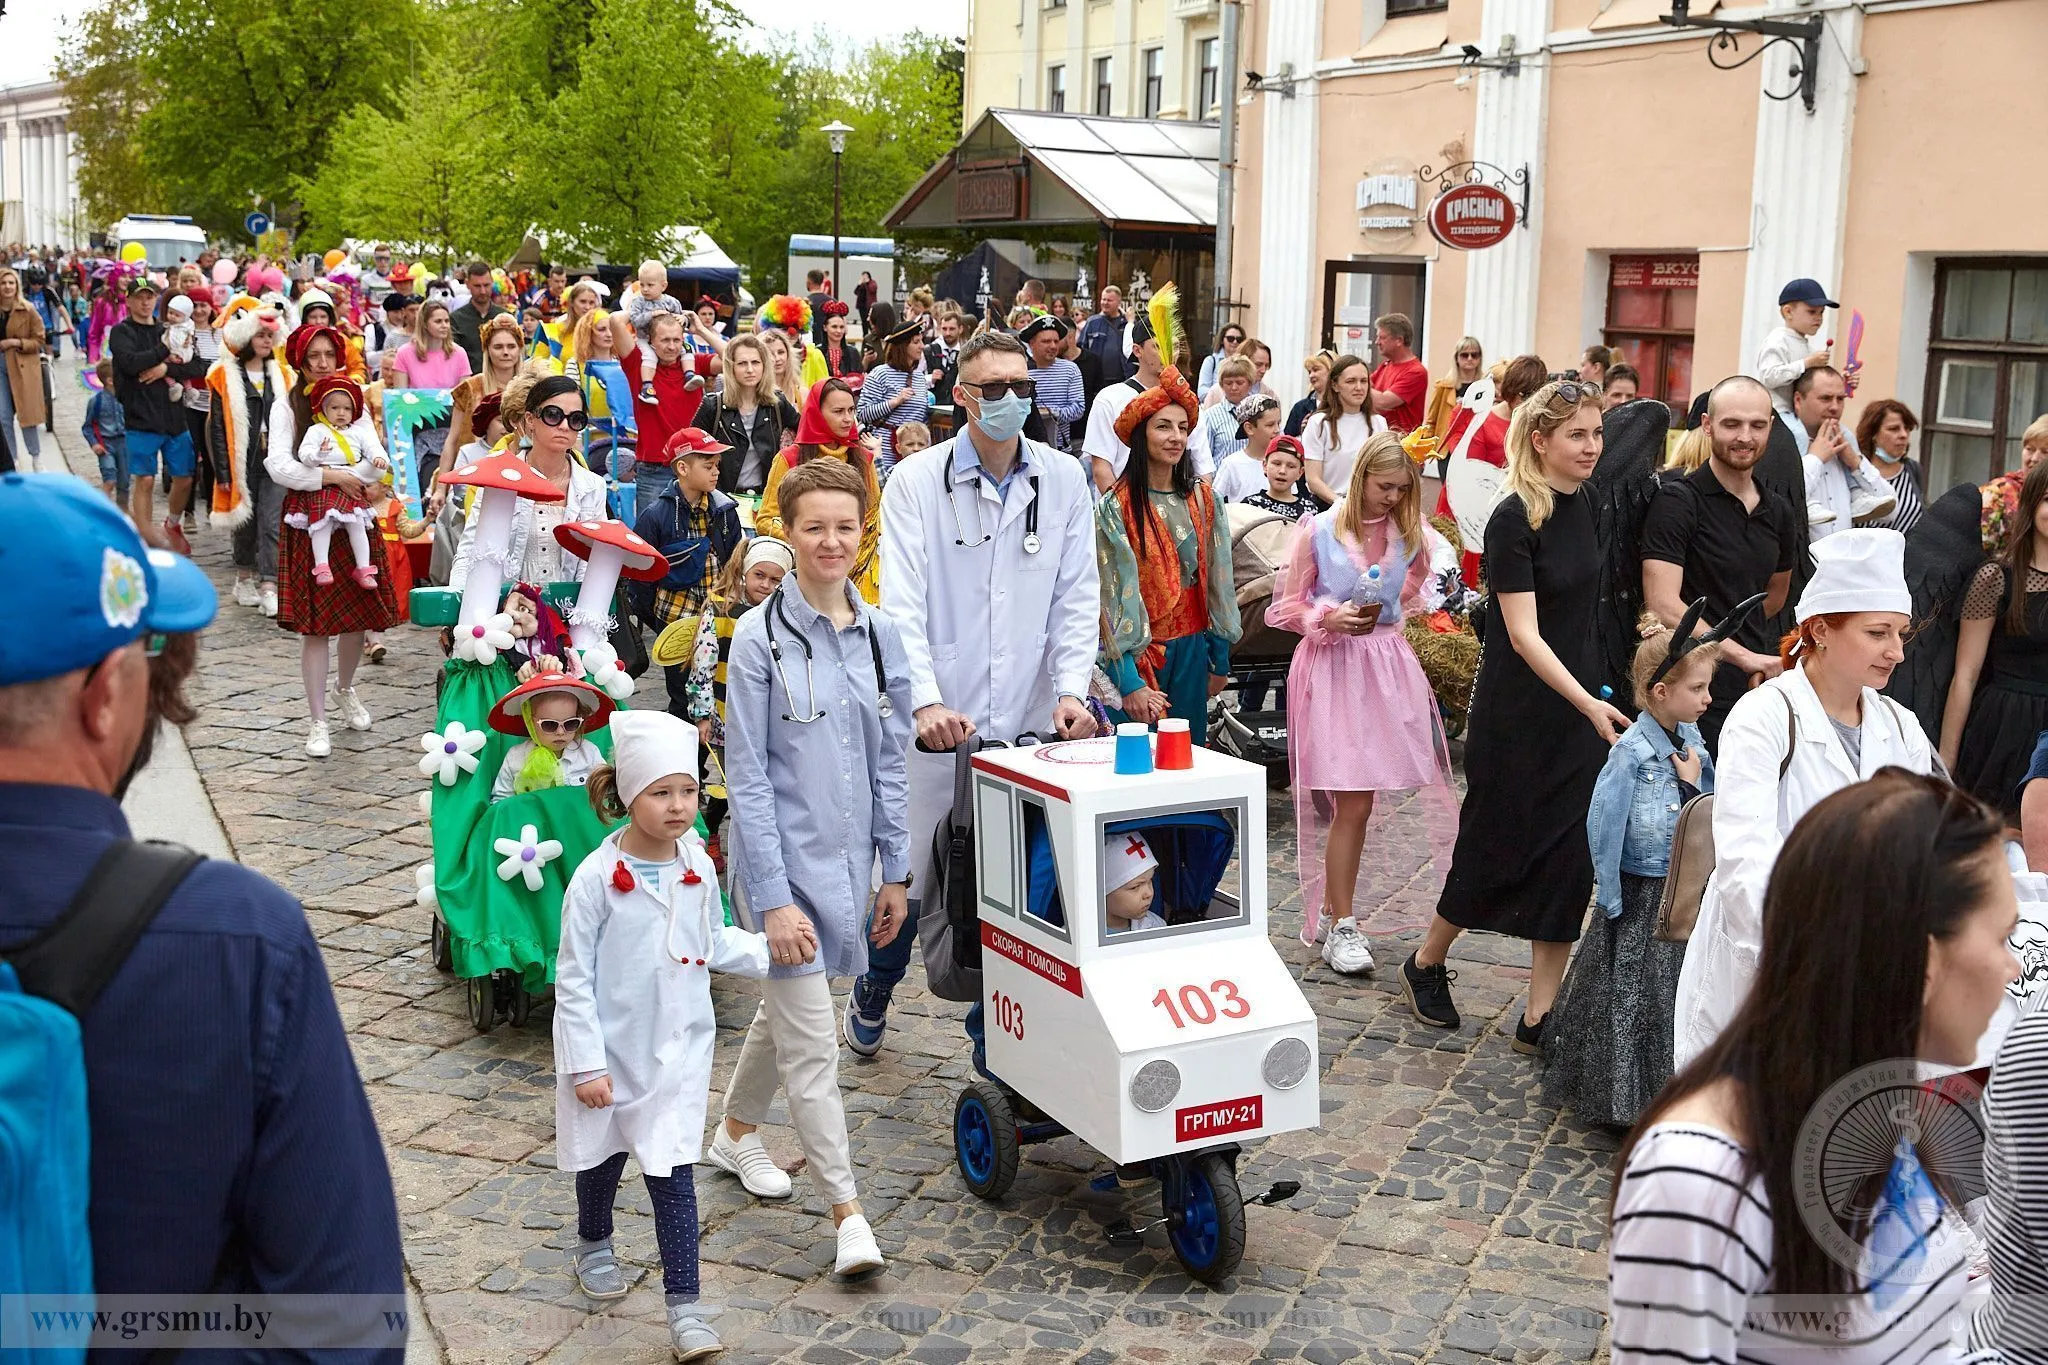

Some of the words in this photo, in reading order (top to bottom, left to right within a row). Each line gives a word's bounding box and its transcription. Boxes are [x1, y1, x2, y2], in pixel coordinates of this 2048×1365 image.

[1446, 196, 1505, 224] КРАСНЫЙ
[991, 932, 1024, 960] СКОРАЯ
[1026, 949, 1067, 982] ПОМОЩЬ
[992, 989, 1025, 1041] 103
[1151, 979, 1251, 1029] 103
[1183, 1103, 1257, 1133] ГРГМУ-21
